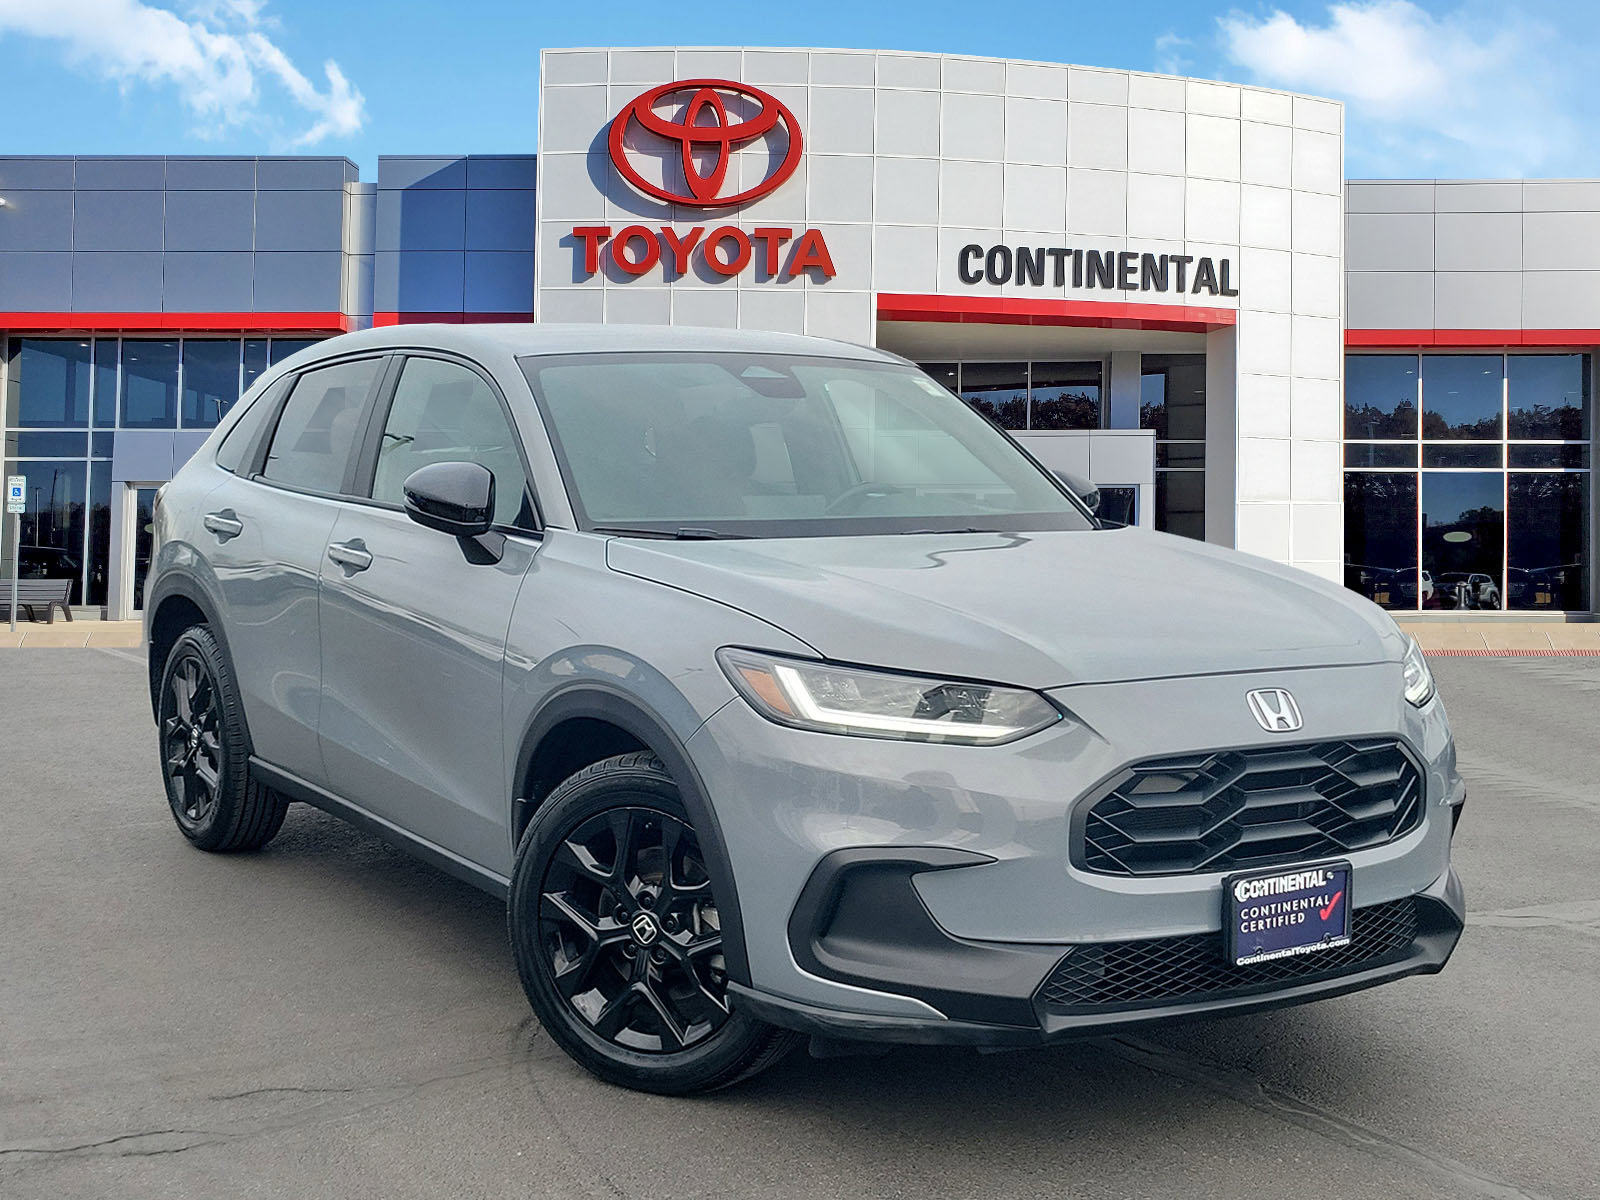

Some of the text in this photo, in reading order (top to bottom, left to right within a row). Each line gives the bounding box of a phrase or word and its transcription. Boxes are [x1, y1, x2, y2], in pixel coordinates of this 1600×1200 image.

[572, 225, 837, 277] TOYOTA
[958, 244, 1239, 297] CONTINENTAL
[1235, 869, 1326, 902] CONTINENTAL
[1240, 894, 1330, 920] CONTINENTAL
[1240, 912, 1305, 934] CERTIFIED
[1236, 938, 1350, 966] ContinentalToyota.com
